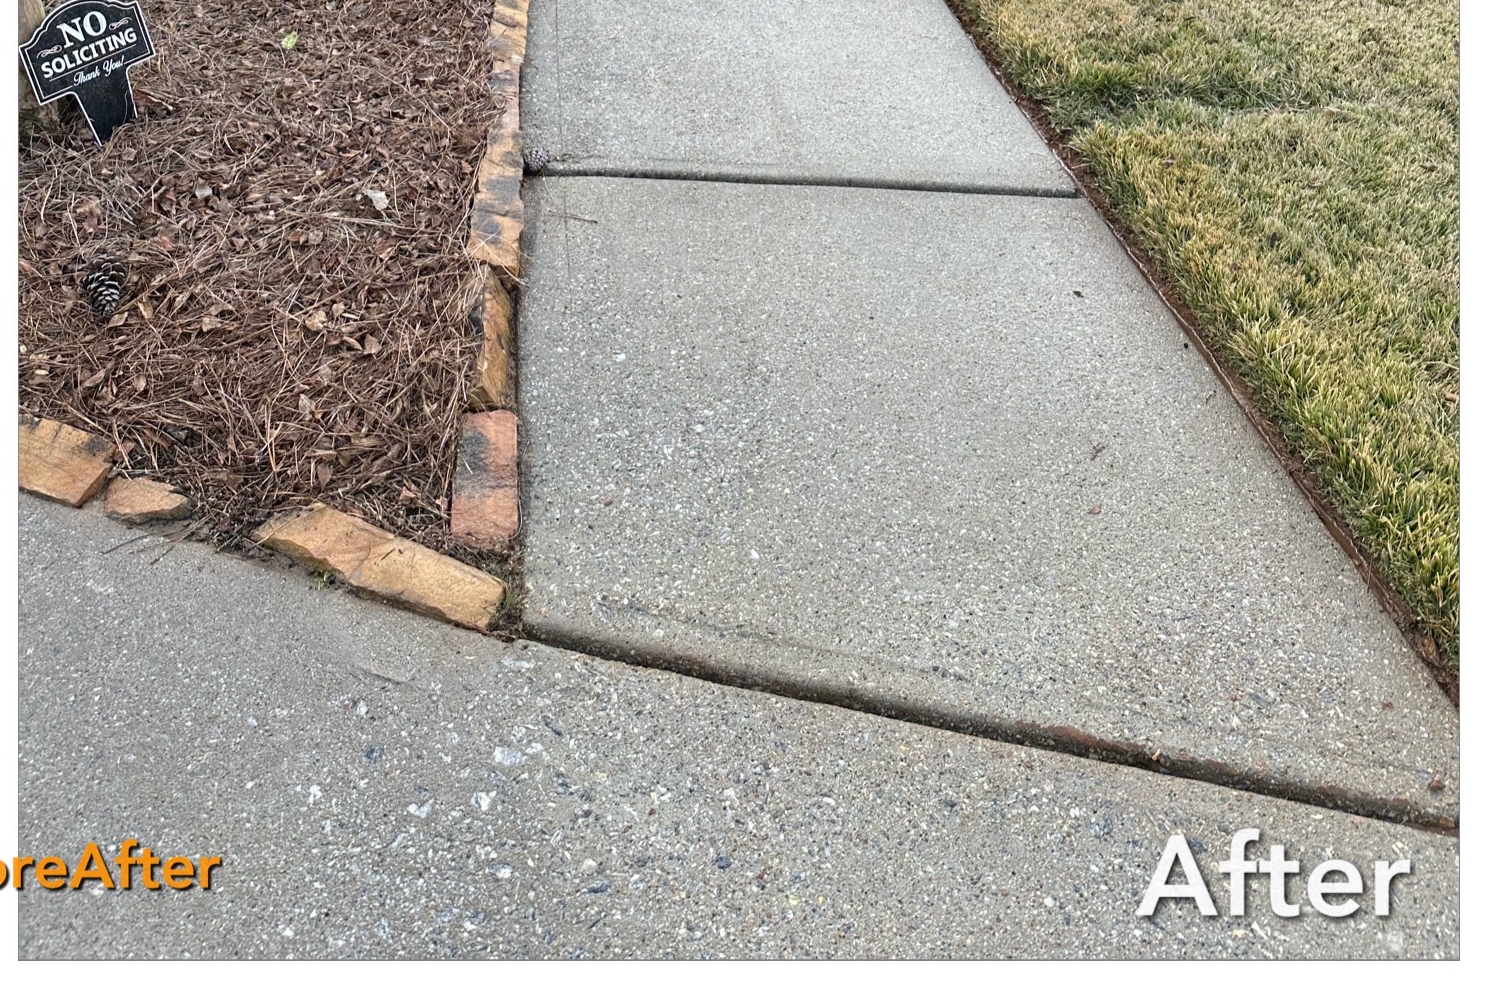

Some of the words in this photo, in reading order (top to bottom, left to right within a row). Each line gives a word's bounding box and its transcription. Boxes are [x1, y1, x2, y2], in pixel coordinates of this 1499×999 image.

[56, 10, 107, 49] NO
[41, 28, 137, 78] SOLICITING
[73, 67, 101, 86] Thank
[103, 55, 126, 77] You!
